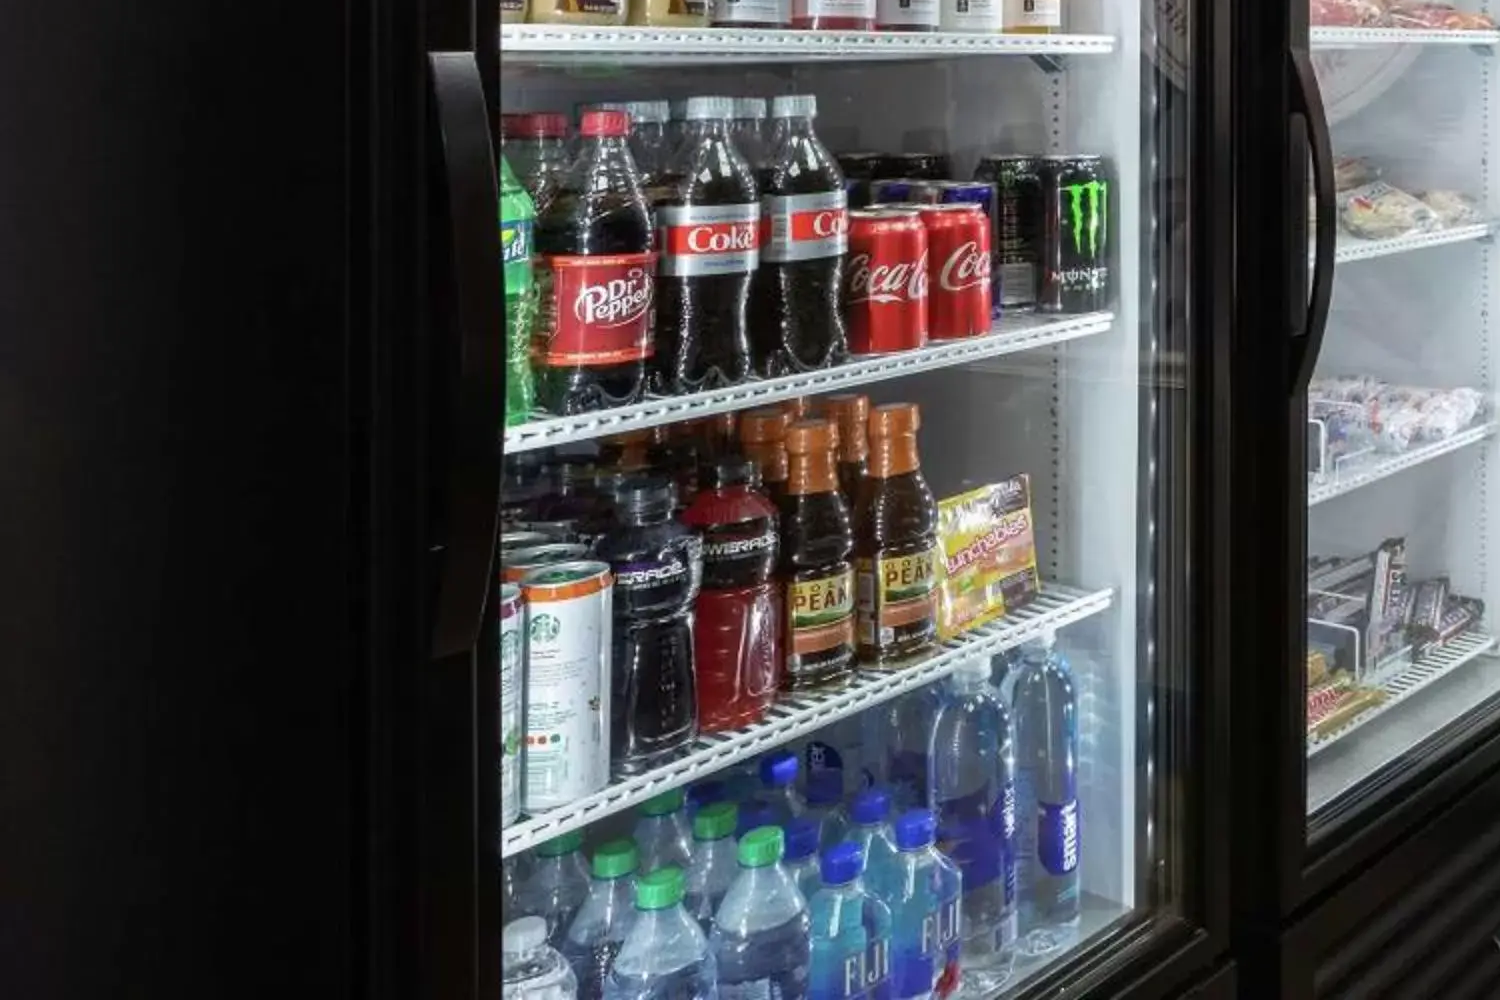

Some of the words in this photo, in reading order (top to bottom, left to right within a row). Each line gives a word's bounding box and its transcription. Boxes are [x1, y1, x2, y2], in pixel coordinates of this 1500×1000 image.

[687, 223, 755, 252] Coke
[813, 209, 847, 237] Co
[584, 271, 654, 325] Pepper
[608, 278, 638, 301] Dr
[945, 513, 1029, 574] Lunchables
[922, 897, 961, 954] FIJI
[844, 938, 889, 997] FIJI
